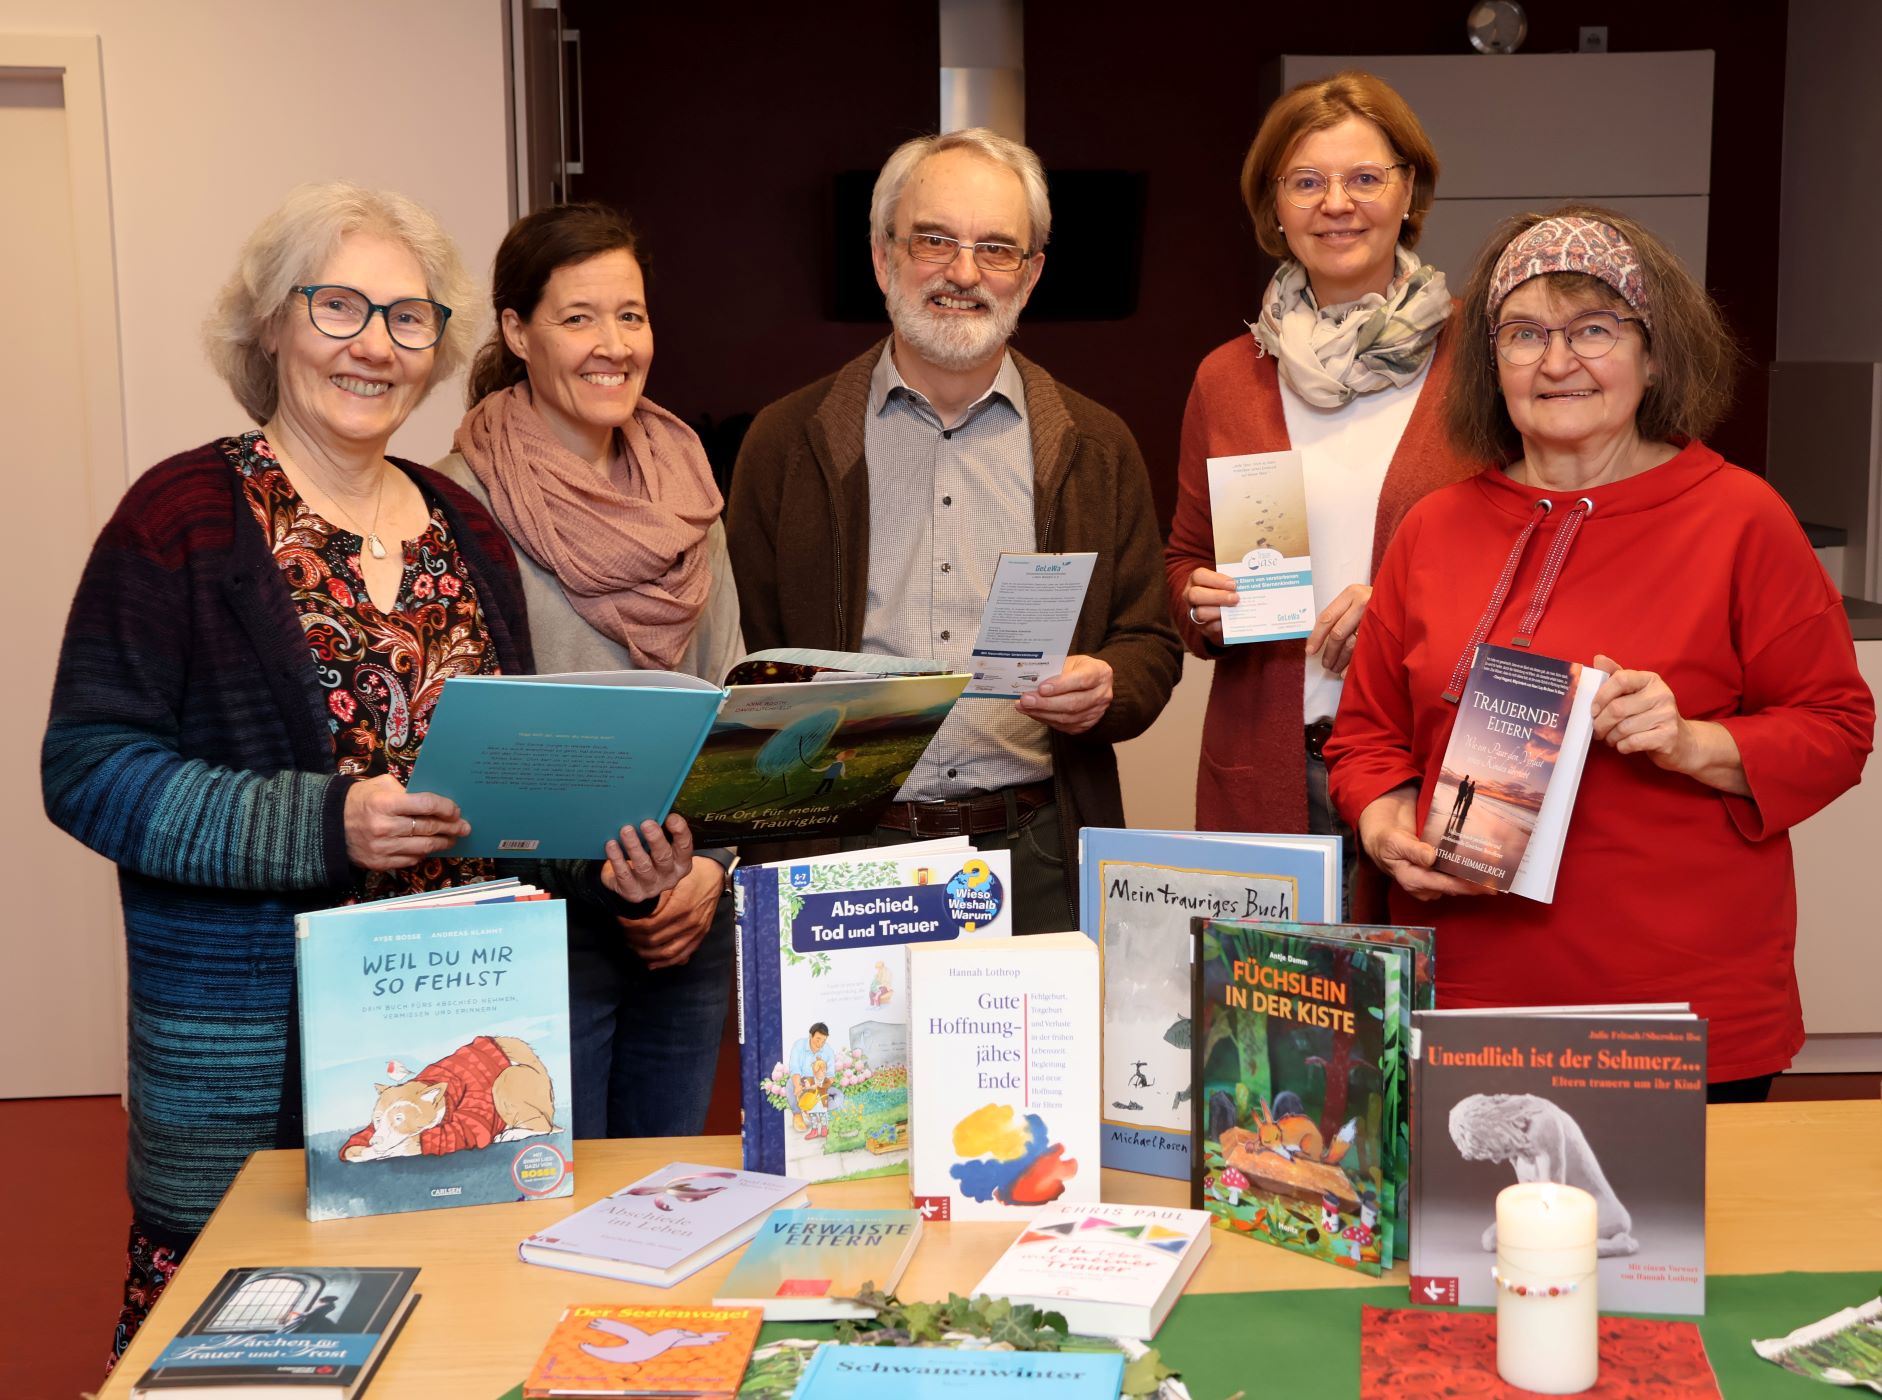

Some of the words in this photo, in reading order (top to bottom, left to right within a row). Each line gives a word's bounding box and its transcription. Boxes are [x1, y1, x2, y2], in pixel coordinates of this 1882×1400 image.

[1472, 690, 1560, 729] TRAUERNDE
[1486, 714, 1533, 741] ELTERN
[704, 812, 727, 822] Ein
[732, 809, 757, 820] Ort
[762, 807, 785, 818] für
[788, 804, 831, 816] meine
[751, 813, 840, 831] Traurigkeit
[1434, 846, 1462, 865] ATHALIE
[1460, 856, 1507, 880] HIMMELRICH
[793, 873, 807, 882] 4-7
[956, 888, 991, 900] Wieso
[1109, 879, 1155, 903] Mein
[1156, 884, 1239, 918] trauriges
[1241, 887, 1290, 920] Buch
[831, 895, 920, 918] Abschied,
[948, 898, 997, 910] Weshalb
[951, 909, 993, 921] Warum
[811, 923, 844, 942] Tod
[848, 925, 875, 939] und
[878, 918, 940, 937] Trauer
[362, 951, 417, 976] WEIL
[428, 949, 461, 967] DU
[471, 945, 514, 965] MIR
[1269, 951, 1287, 963] Antje
[1287, 955, 1309, 967] Damm
[949, 968, 983, 977] Hannah
[985, 968, 1021, 979] Lothrop
[1233, 956, 1347, 1006] FÜCHSLEIN
[372, 977, 405, 997] SO
[414, 970, 508, 993] FEHLST
[977, 992, 1021, 1010] Gute
[1225, 984, 1248, 1010] IN
[1252, 989, 1293, 1020] DER
[1297, 1000, 1356, 1035] KISTE
[928, 1016, 1022, 1039] Hoffnung-
[1030, 1019, 1045, 1028] und
[975, 1044, 1021, 1068] jähes
[1427, 1045, 1525, 1068] Unendlich
[1529, 1047, 1554, 1069] ist
[1559, 1048, 1593, 1070] der
[1597, 1048, 1701, 1072] Schmerz...
[976, 1071, 1021, 1090] Ende
[1551, 1075, 1587, 1088] Eltern
[1589, 1077, 1631, 1089] trauern
[1633, 1079, 1652, 1090] um
[1654, 1077, 1671, 1090] ihr
[1674, 1078, 1702, 1091] Kind
[1111, 1131, 1158, 1148] Michael
[1158, 1136, 1188, 1154] Rosen
[430, 1187, 462, 1197] CARLSEN
[1060, 1206, 1122, 1217] CHRIS
[1133, 1209, 1185, 1221] PAUL
[773, 1222, 912, 1236] VERWAISTE
[784, 1233, 883, 1247] ELTERN
[574, 1307, 614, 1318] Der
[617, 1308, 751, 1321] Seelenvogel
[211, 1333, 312, 1349] Märchen
[315, 1338, 340, 1348] für
[166, 1344, 246, 1362] Trauer
[247, 1350, 279, 1360] und
[281, 1344, 349, 1360] Trost
[836, 1361, 1087, 1381] Schwanenwinter
